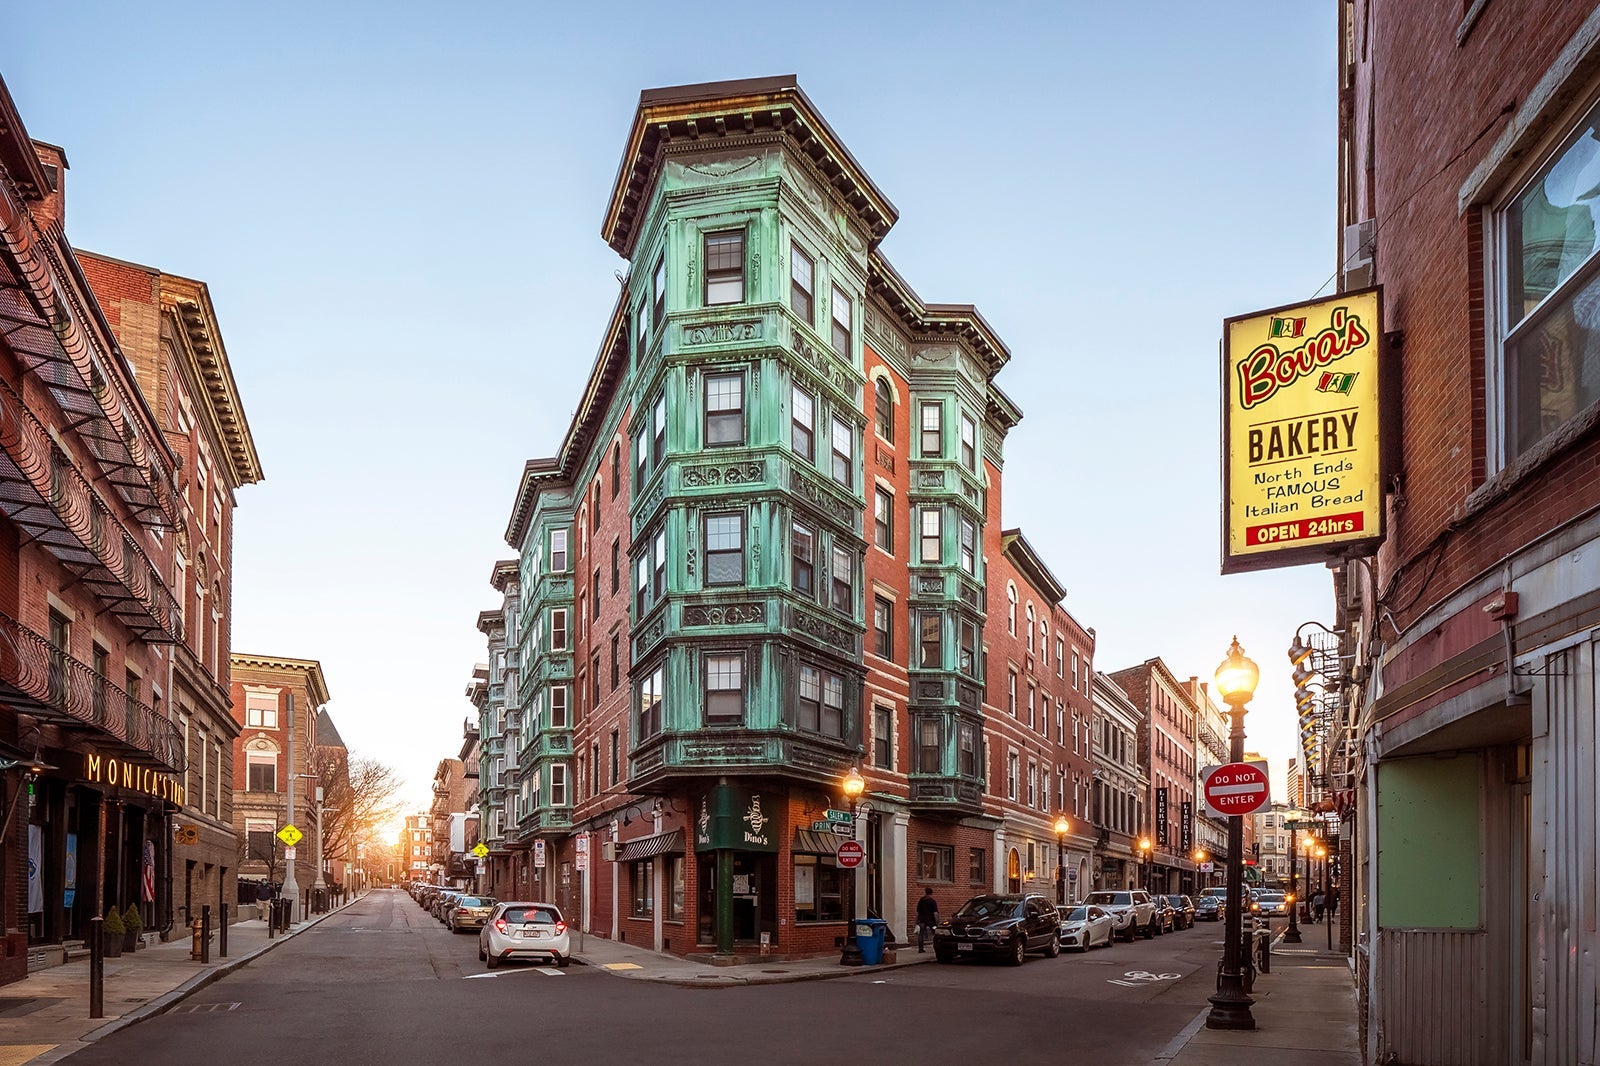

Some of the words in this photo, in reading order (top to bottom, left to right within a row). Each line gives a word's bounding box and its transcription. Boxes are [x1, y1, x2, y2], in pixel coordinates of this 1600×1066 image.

[1237, 306, 1370, 410] Bova's
[1249, 411, 1359, 463] BAKERY
[1254, 467, 1302, 484] North
[1313, 457, 1353, 475] End's
[1245, 502, 1299, 518] Italian
[1311, 489, 1363, 508] Bread
[1257, 523, 1300, 543] OPEN
[1308, 518, 1354, 536] 24hrs
[88, 753, 167, 799] MONICA'S
[1215, 775, 1229, 785] DO
[1235, 772, 1256, 783] NOT
[1220, 795, 1255, 806] ENTER
[829, 811, 844, 820] SALEM
[744, 831, 768, 846] Dino's
